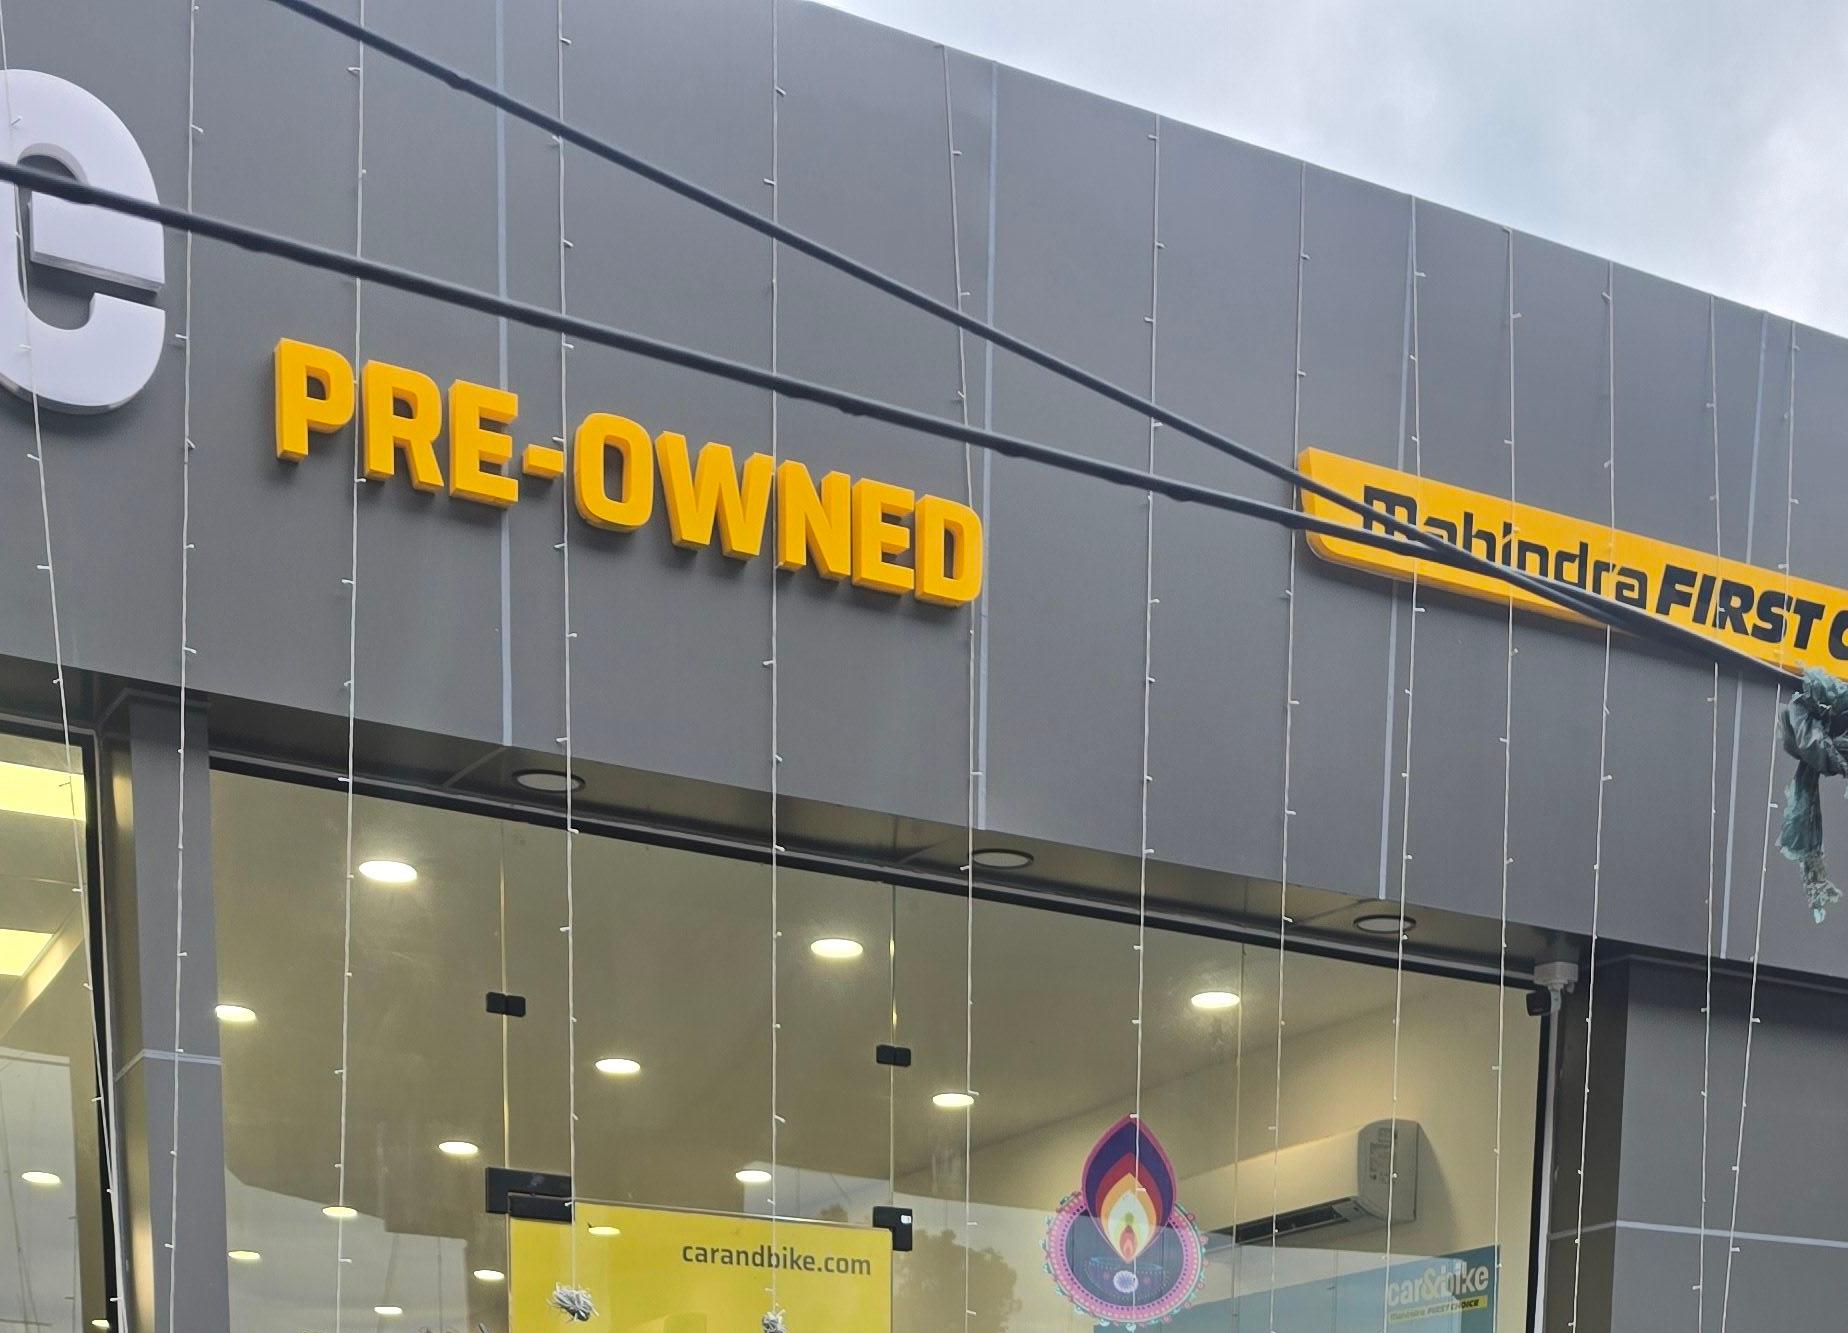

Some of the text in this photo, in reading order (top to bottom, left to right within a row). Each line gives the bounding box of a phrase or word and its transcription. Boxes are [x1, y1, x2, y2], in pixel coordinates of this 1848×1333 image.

[273, 336, 983, 608] PRE-OWNED
[1363, 485, 1649, 609] Mahindra
[1656, 564, 1825, 650] FIRST
[682, 1245, 871, 1275] carandbike.com
